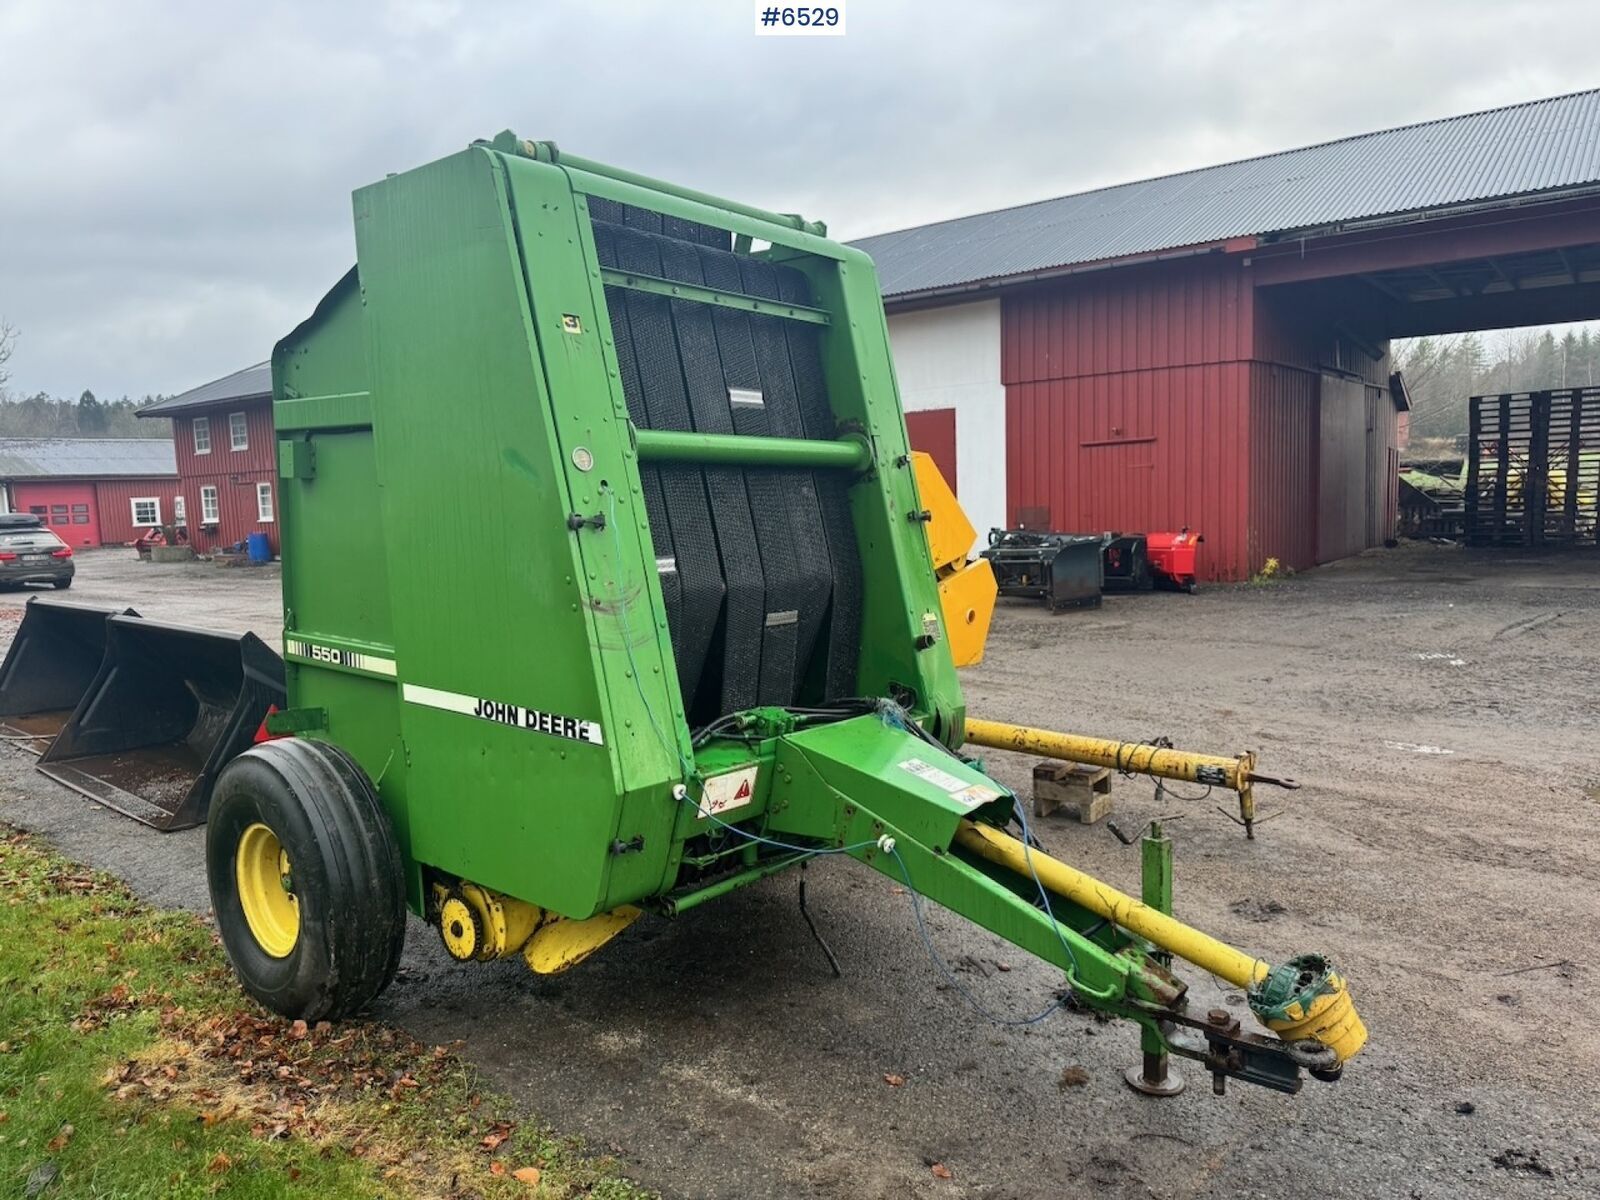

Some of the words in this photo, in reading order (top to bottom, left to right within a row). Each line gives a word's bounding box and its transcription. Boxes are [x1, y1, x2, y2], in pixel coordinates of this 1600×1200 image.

[312, 644, 341, 664] 550
[474, 698, 518, 726] JOHN
[525, 709, 589, 740] DEERE
